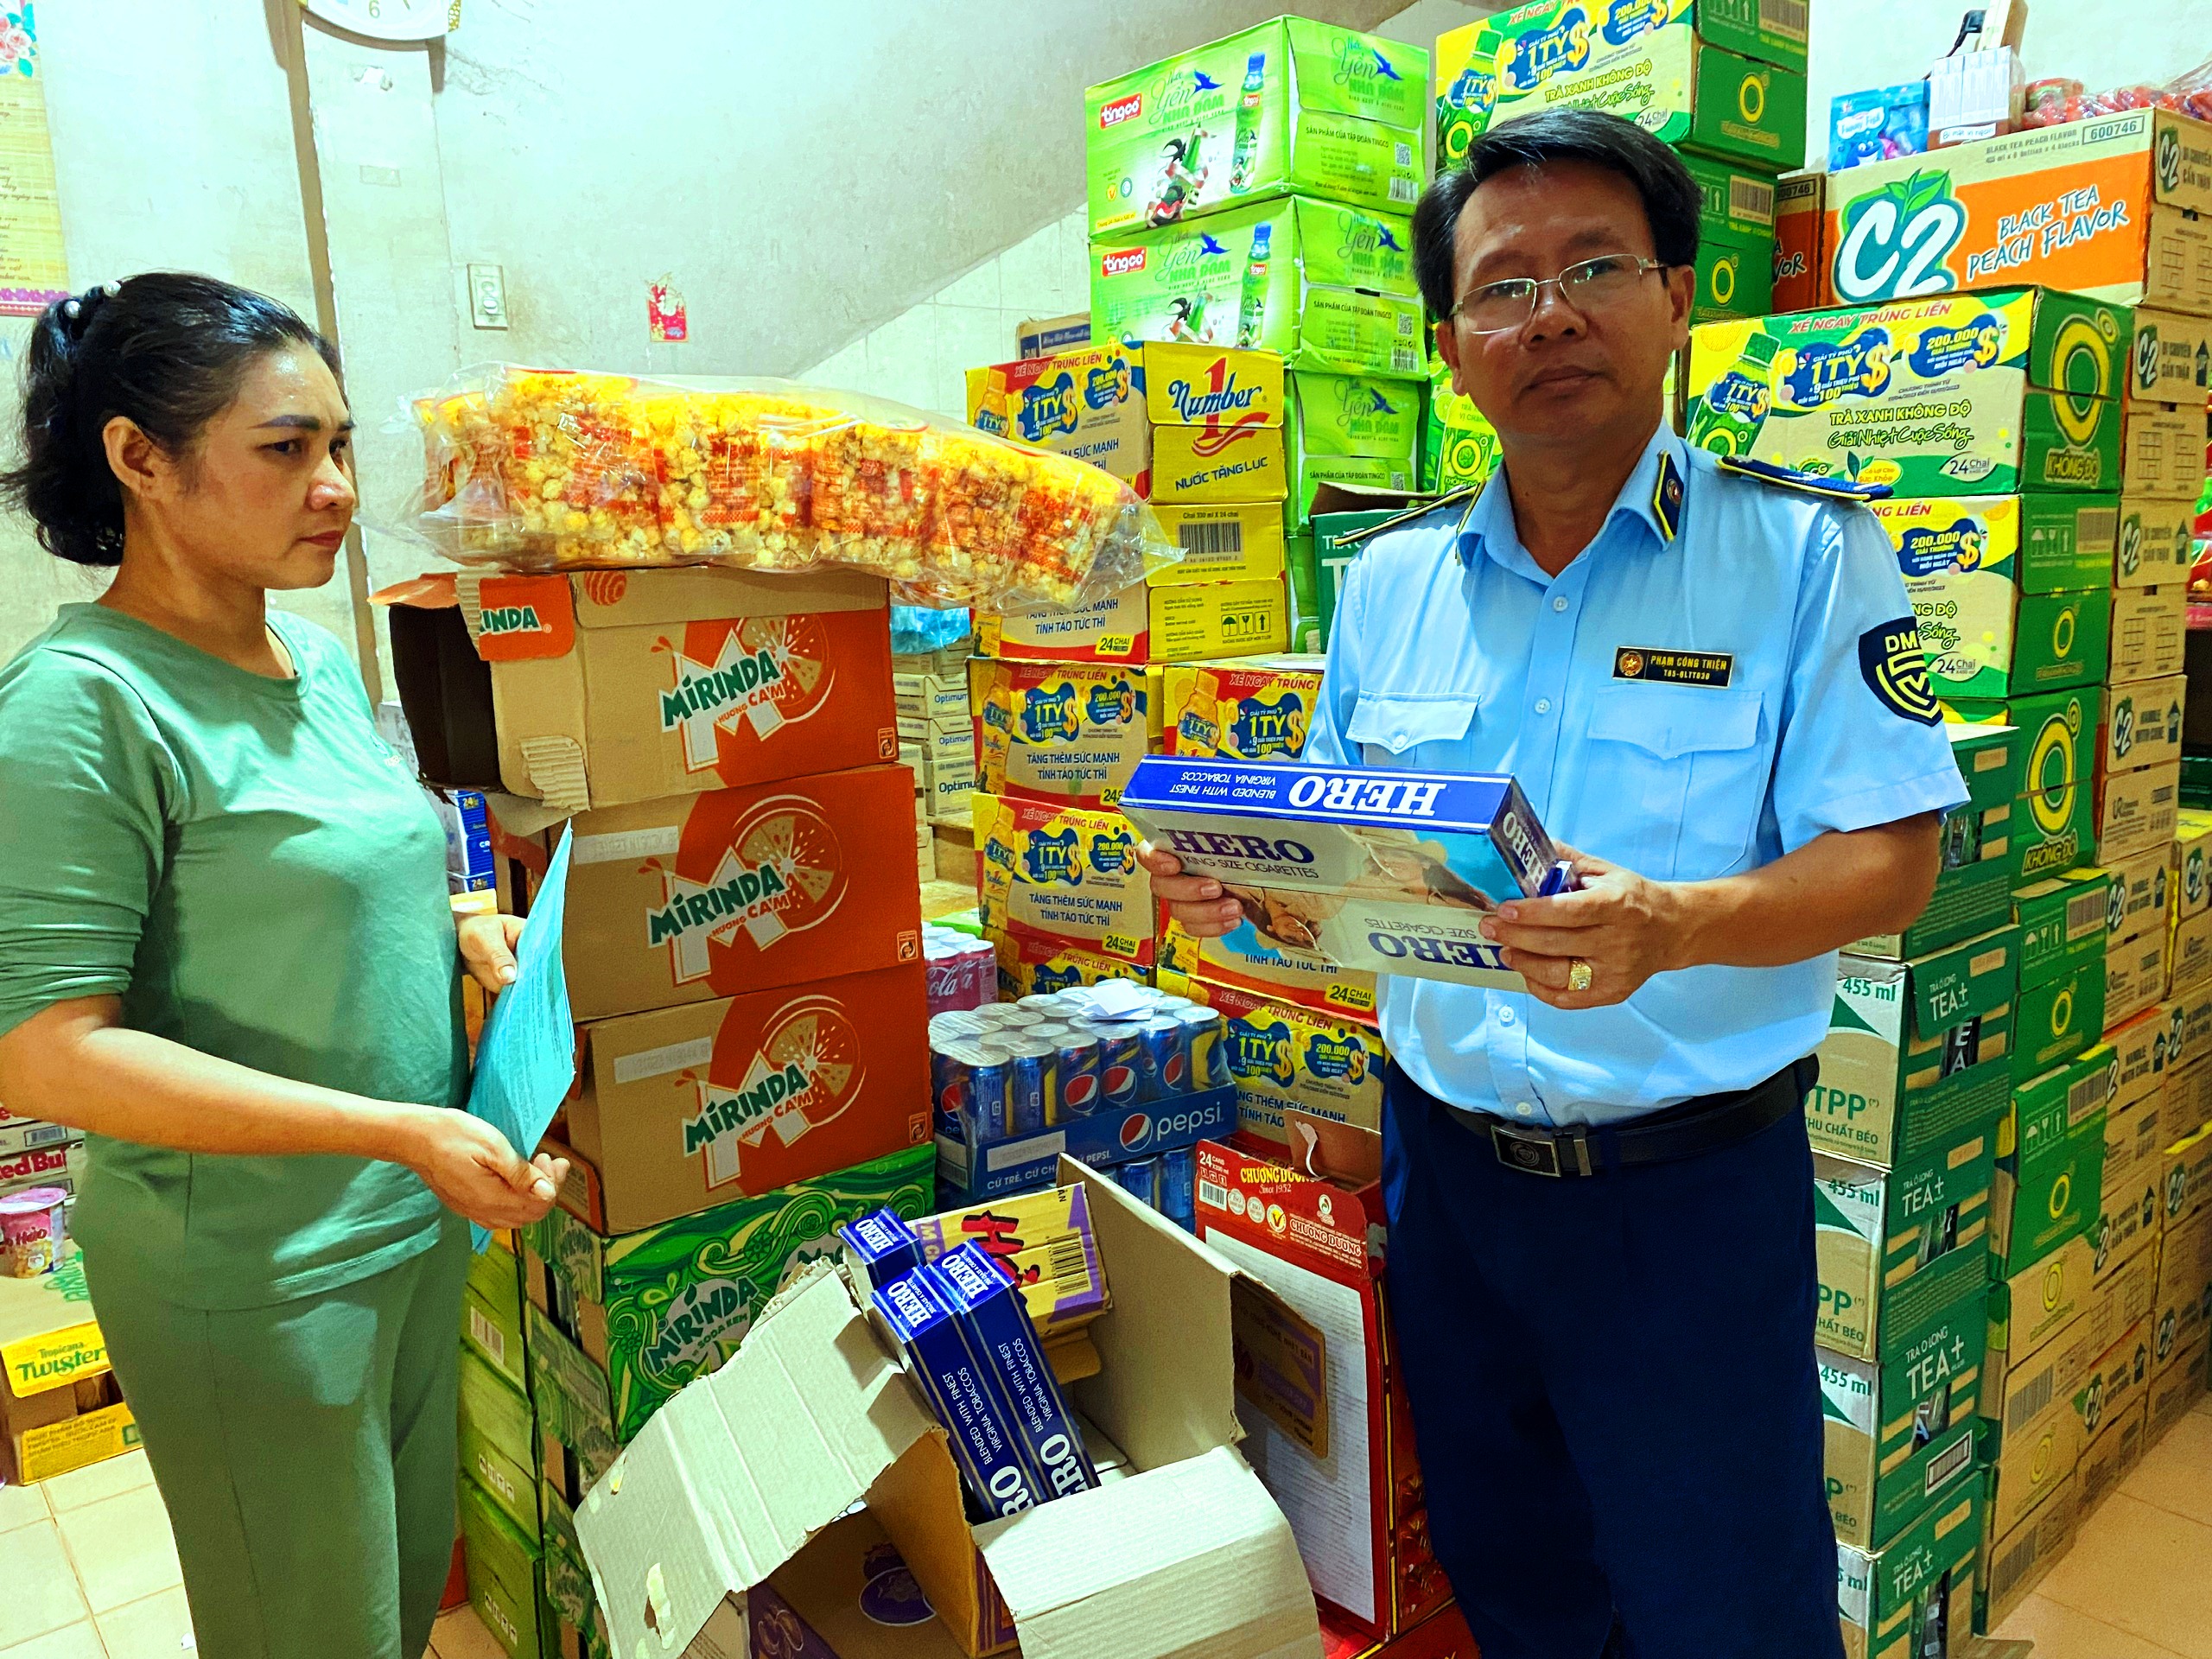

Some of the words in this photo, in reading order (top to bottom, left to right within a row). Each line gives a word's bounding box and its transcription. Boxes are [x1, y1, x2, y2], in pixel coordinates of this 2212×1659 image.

[1565, 80, 1594, 97] XANH
[1595, 69, 1632, 90] KHÔNG
[1635, 58, 1652, 79] ĐỘ
[1102, 96, 1140, 124] tingco
[2090, 119, 2137, 141] 600746
[1998, 206, 2052, 242] BLACK
[2059, 184, 2101, 215] TEA
[1837, 198, 1959, 299] C2
[1967, 232, 2033, 283] PEACH
[2042, 200, 2129, 255] FLAVOR
[1103, 250, 1145, 275] tingco
[1788, 316, 1813, 334] XÉ
[1814, 314, 1856, 331] NGAY
[1859, 307, 1913, 327] TRÚNG
[1926, 327, 1980, 351] 200.000
[1167, 370, 1262, 423] Number
[1830, 410, 1853, 427] TRÀ
[1856, 408, 1893, 425] XANH
[1896, 404, 1947, 421] KHÔNG
[1949, 399, 1972, 419] ĐỘ
[1074, 444, 1091, 459] SỨC
[1092, 438, 1119, 456] MẠNH
[1174, 465, 1210, 492] NƯỚC
[1211, 460, 1243, 482] TĂNG
[1244, 455, 1268, 478] LỰC
[1949, 459, 1968, 475] 24
[1910, 531, 1961, 550] 200.000
[1935, 600, 1957, 618] ĐỘ
[1099, 638, 1113, 652] 24
[1114, 637, 1130, 645] CHAI
[1650, 655, 1675, 668] PHẠM
[1677, 657, 1700, 668] CÔNG
[1702, 659, 1727, 672] THIỆN
[1936, 658, 1955, 675] 24
[662, 647, 783, 728] MIRINDA
[747, 682, 786, 709] CAM
[1095, 691, 1121, 702] 200.000
[1276, 677, 1314, 690] TRÚNG
[1073, 750, 1091, 764] SỨC
[1092, 752, 1120, 765] MẠNH
[1256, 743, 1272, 754] 100
[1169, 784, 1201, 795] FINEST
[1201, 785, 1229, 797] WITH
[1236, 774, 1276, 785] VIRGINIA
[1232, 788, 1277, 799] BLENDED
[1288, 773, 1447, 817] HERO
[1158, 828, 1315, 864] HERO
[1184, 855, 1217, 868] KING
[1218, 859, 1243, 871] SIZE
[1244, 862, 1319, 880] CIGARETTES
[648, 863, 786, 945] MIRINDA
[1029, 892, 1052, 905] TĂNG
[1052, 894, 1076, 907] THÊM
[1077, 895, 1095, 909] SỨC
[1096, 900, 1122, 913] MẠNH
[1363, 917, 1444, 938] CIGARETTES
[1105, 935, 1119, 950] 24
[1119, 937, 1136, 948] CHAI
[1330, 985, 1350, 1001] 24
[1350, 988, 1372, 1001] CHAI
[1842, 978, 1872, 997] 455
[1875, 984, 1897, 1001] ml
[684, 1061, 811, 1155] MIRINDA
[1156, 1101, 1221, 1141] pepsi
[1199, 1150, 1212, 1167] 24
[987, 1178, 1001, 1190] CỨ
[1275, 1183, 1292, 1193] 1952
[855, 1218, 894, 1254] HERO
[941, 1253, 989, 1300] HERO
[887, 1281, 932, 1328] HERO
[648, 1279, 757, 1372] MIRINDA
[698, 1325, 726, 1349] SODA
[1842, 1325, 1865, 1343] BÉO
[15, 1347, 106, 1382] Twister
[998, 1342, 1019, 1373] FINEST
[942, 1371, 966, 1402] FINEST
[1011, 1369, 1029, 1397] WITH
[1821, 1364, 1847, 1389] 455
[1850, 1375, 1872, 1397] ml
[957, 1397, 975, 1428] WITH
[1020, 1395, 1045, 1434] BLENDED
[1033, 1384, 1054, 1421] VIRGINIA
[969, 1425, 995, 1465] BLENDED
[981, 1415, 1003, 1452] VIRGINIA
